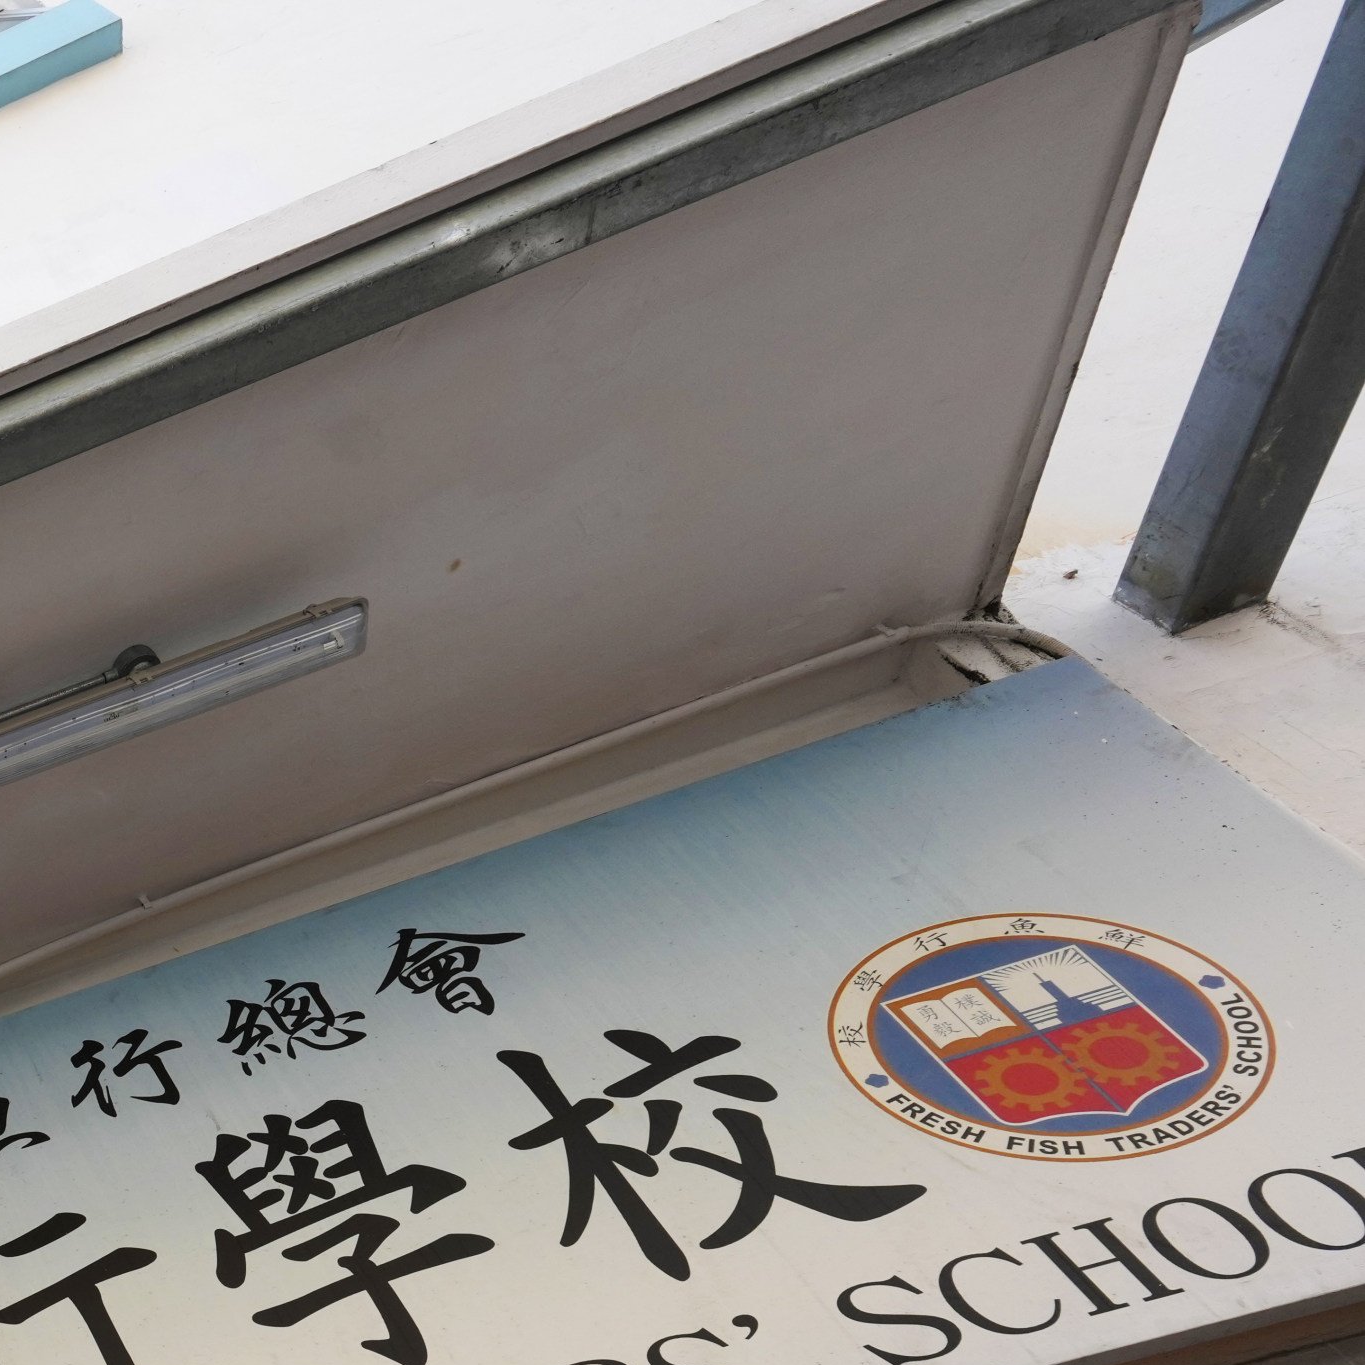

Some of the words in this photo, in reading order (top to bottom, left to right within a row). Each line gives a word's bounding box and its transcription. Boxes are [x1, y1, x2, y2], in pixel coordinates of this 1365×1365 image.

[839, 918, 1145, 1047] 鮮魚行學校
[886, 1092, 986, 1144] FRESH
[1006, 1136, 1086, 1156] FISH
[1220, 993, 1263, 1077] SCHOOL
